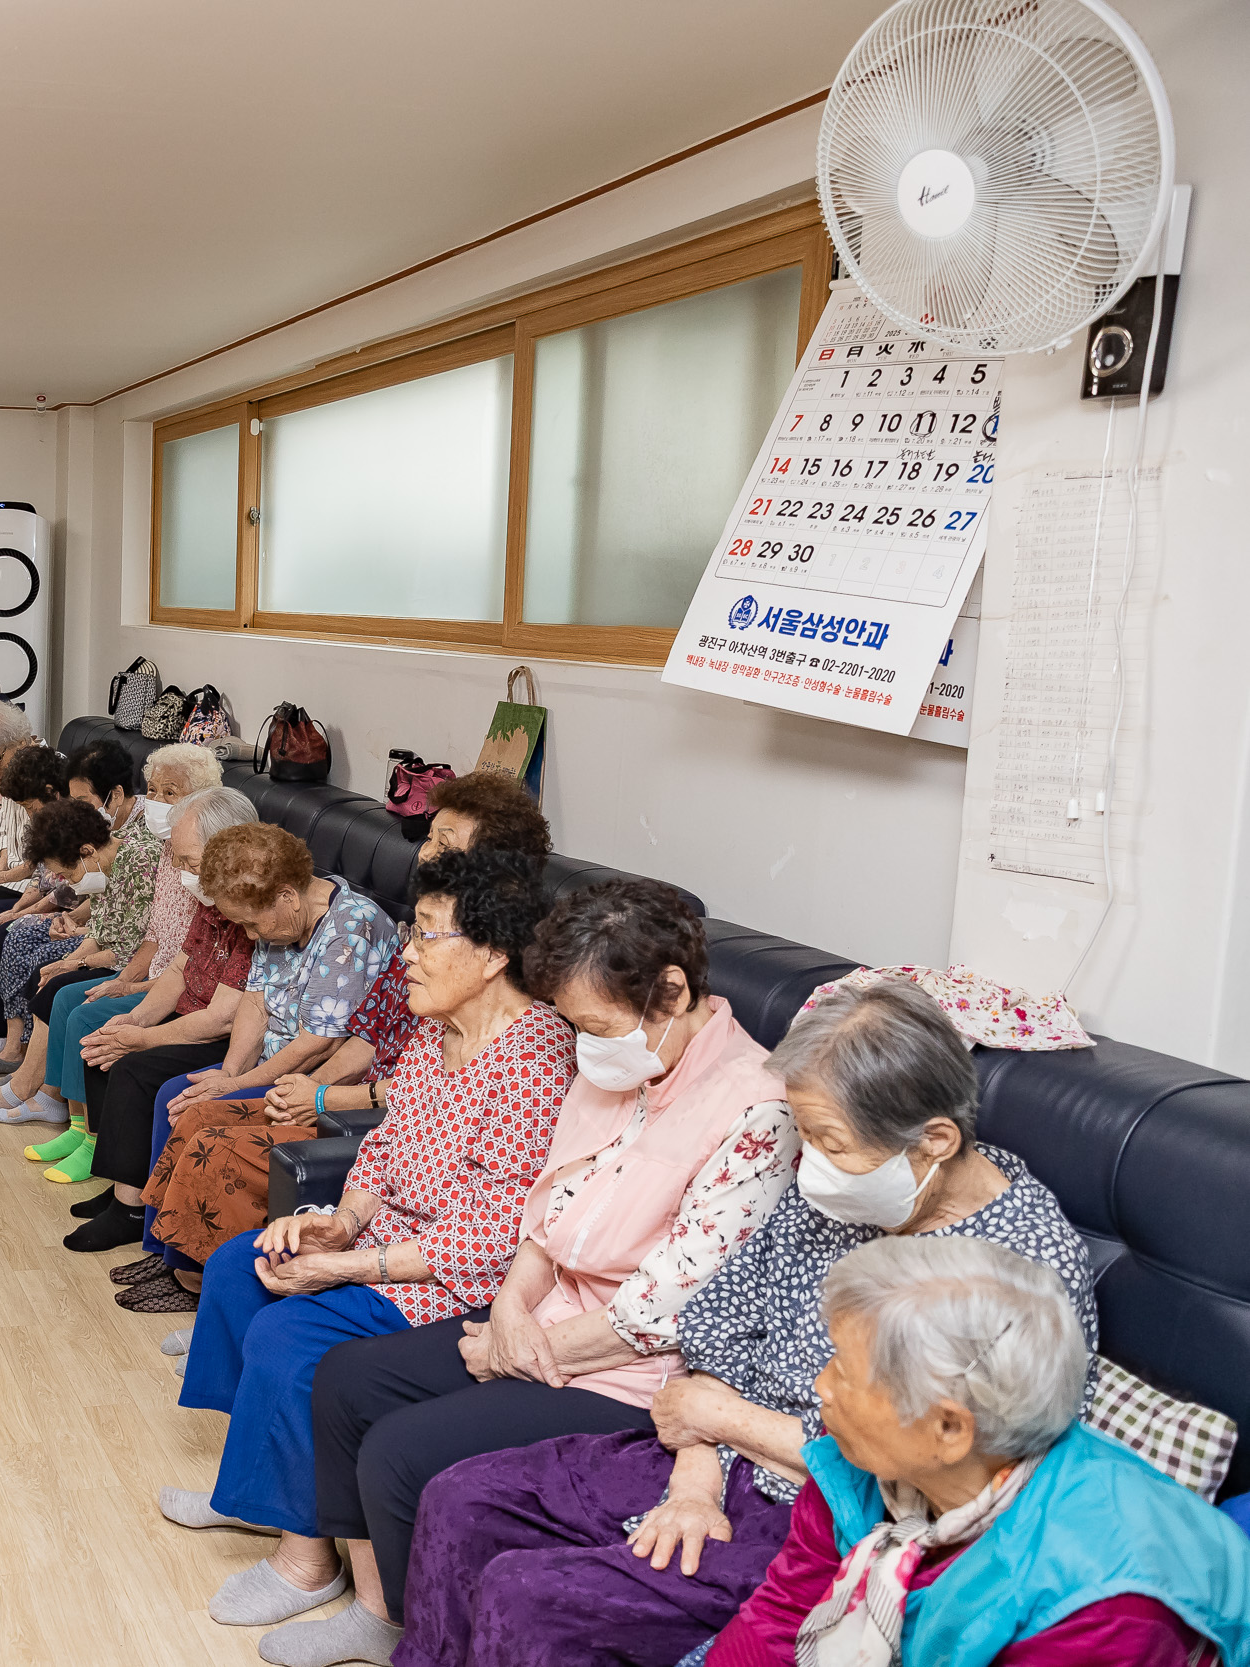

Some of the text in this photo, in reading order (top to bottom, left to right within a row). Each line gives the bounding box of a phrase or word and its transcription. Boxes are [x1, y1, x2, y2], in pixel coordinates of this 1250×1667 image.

[875, 343, 895, 356] 火
[907, 341, 927, 354] 水
[840, 370, 850, 388] 1
[867, 368, 882, 388] 2
[900, 366, 914, 386] 3
[932, 364, 948, 384] 4
[970, 364, 988, 385] 5
[790, 414, 804, 432] 7
[819, 413, 832, 432] 8
[850, 413, 864, 432] 9
[878, 413, 902, 433] 10
[914, 412, 937, 433] 11
[950, 413, 977, 434] 12
[769, 457, 994, 484] 14 15 16 17 18 19 20
[749, 498, 978, 531] 21 22 23 24 25 26 27
[728, 538, 753, 557] 28
[756, 540, 783, 559] 29
[788, 543, 815, 563] 30
[757, 605, 890, 651] 서울삼성안과
[698, 634, 896, 684] 광진구 아차산역 3번출구 02-2201-2020
[927, 681, 965, 699] 1-2020
